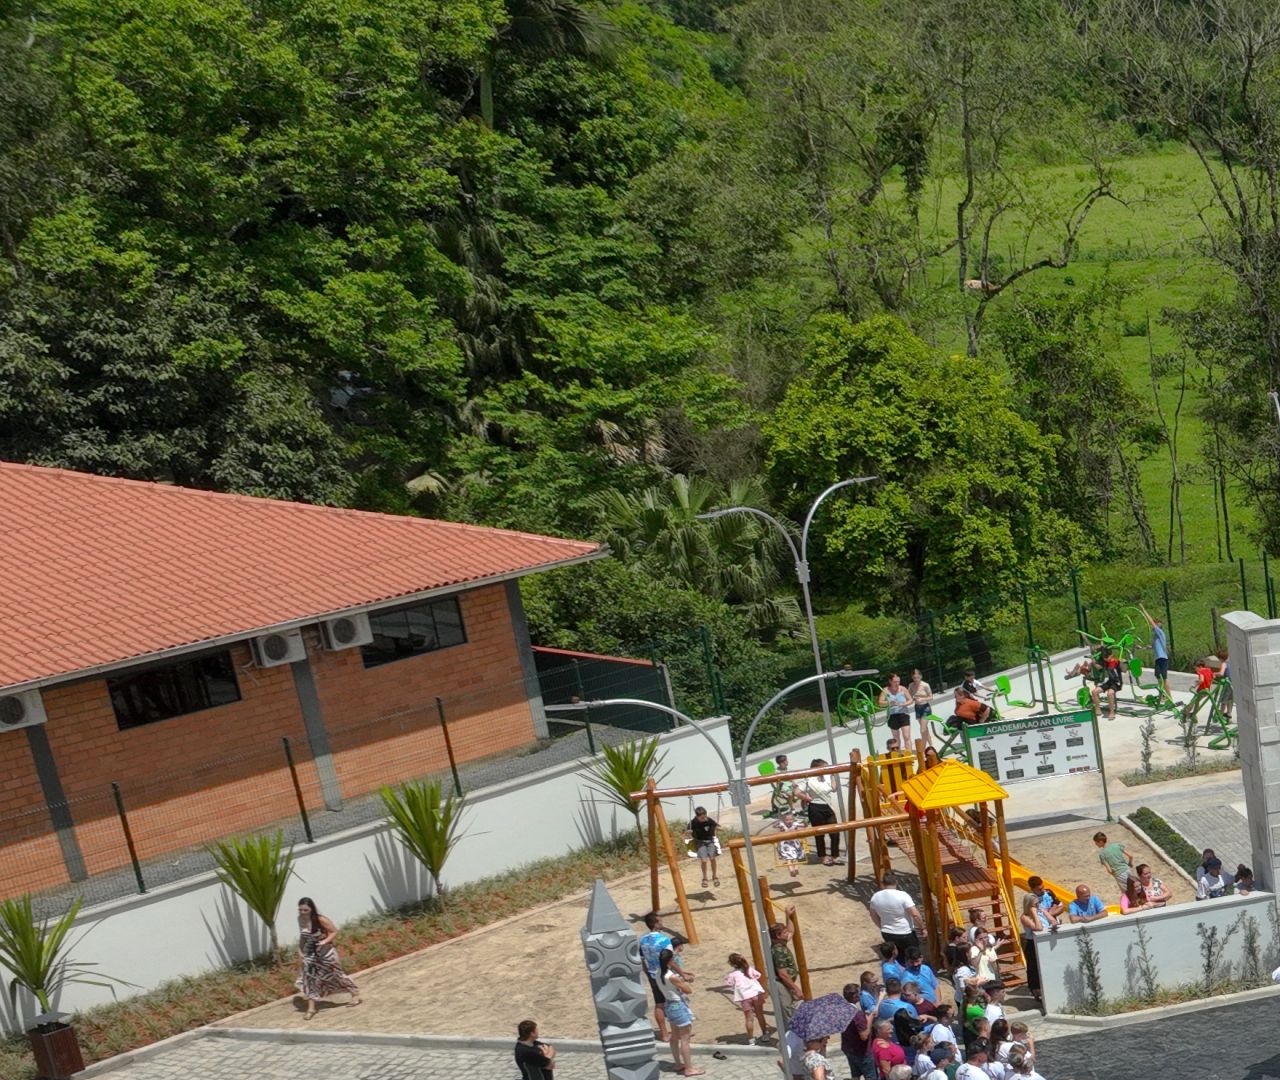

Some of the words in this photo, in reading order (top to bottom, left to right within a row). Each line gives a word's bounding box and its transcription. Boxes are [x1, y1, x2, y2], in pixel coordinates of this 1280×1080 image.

[986, 721, 1026, 735] ACADEMIA
[1026, 721, 1039, 729] AO
[1040, 719, 1051, 727] AR
[1052, 715, 1074, 725] LIVRE
